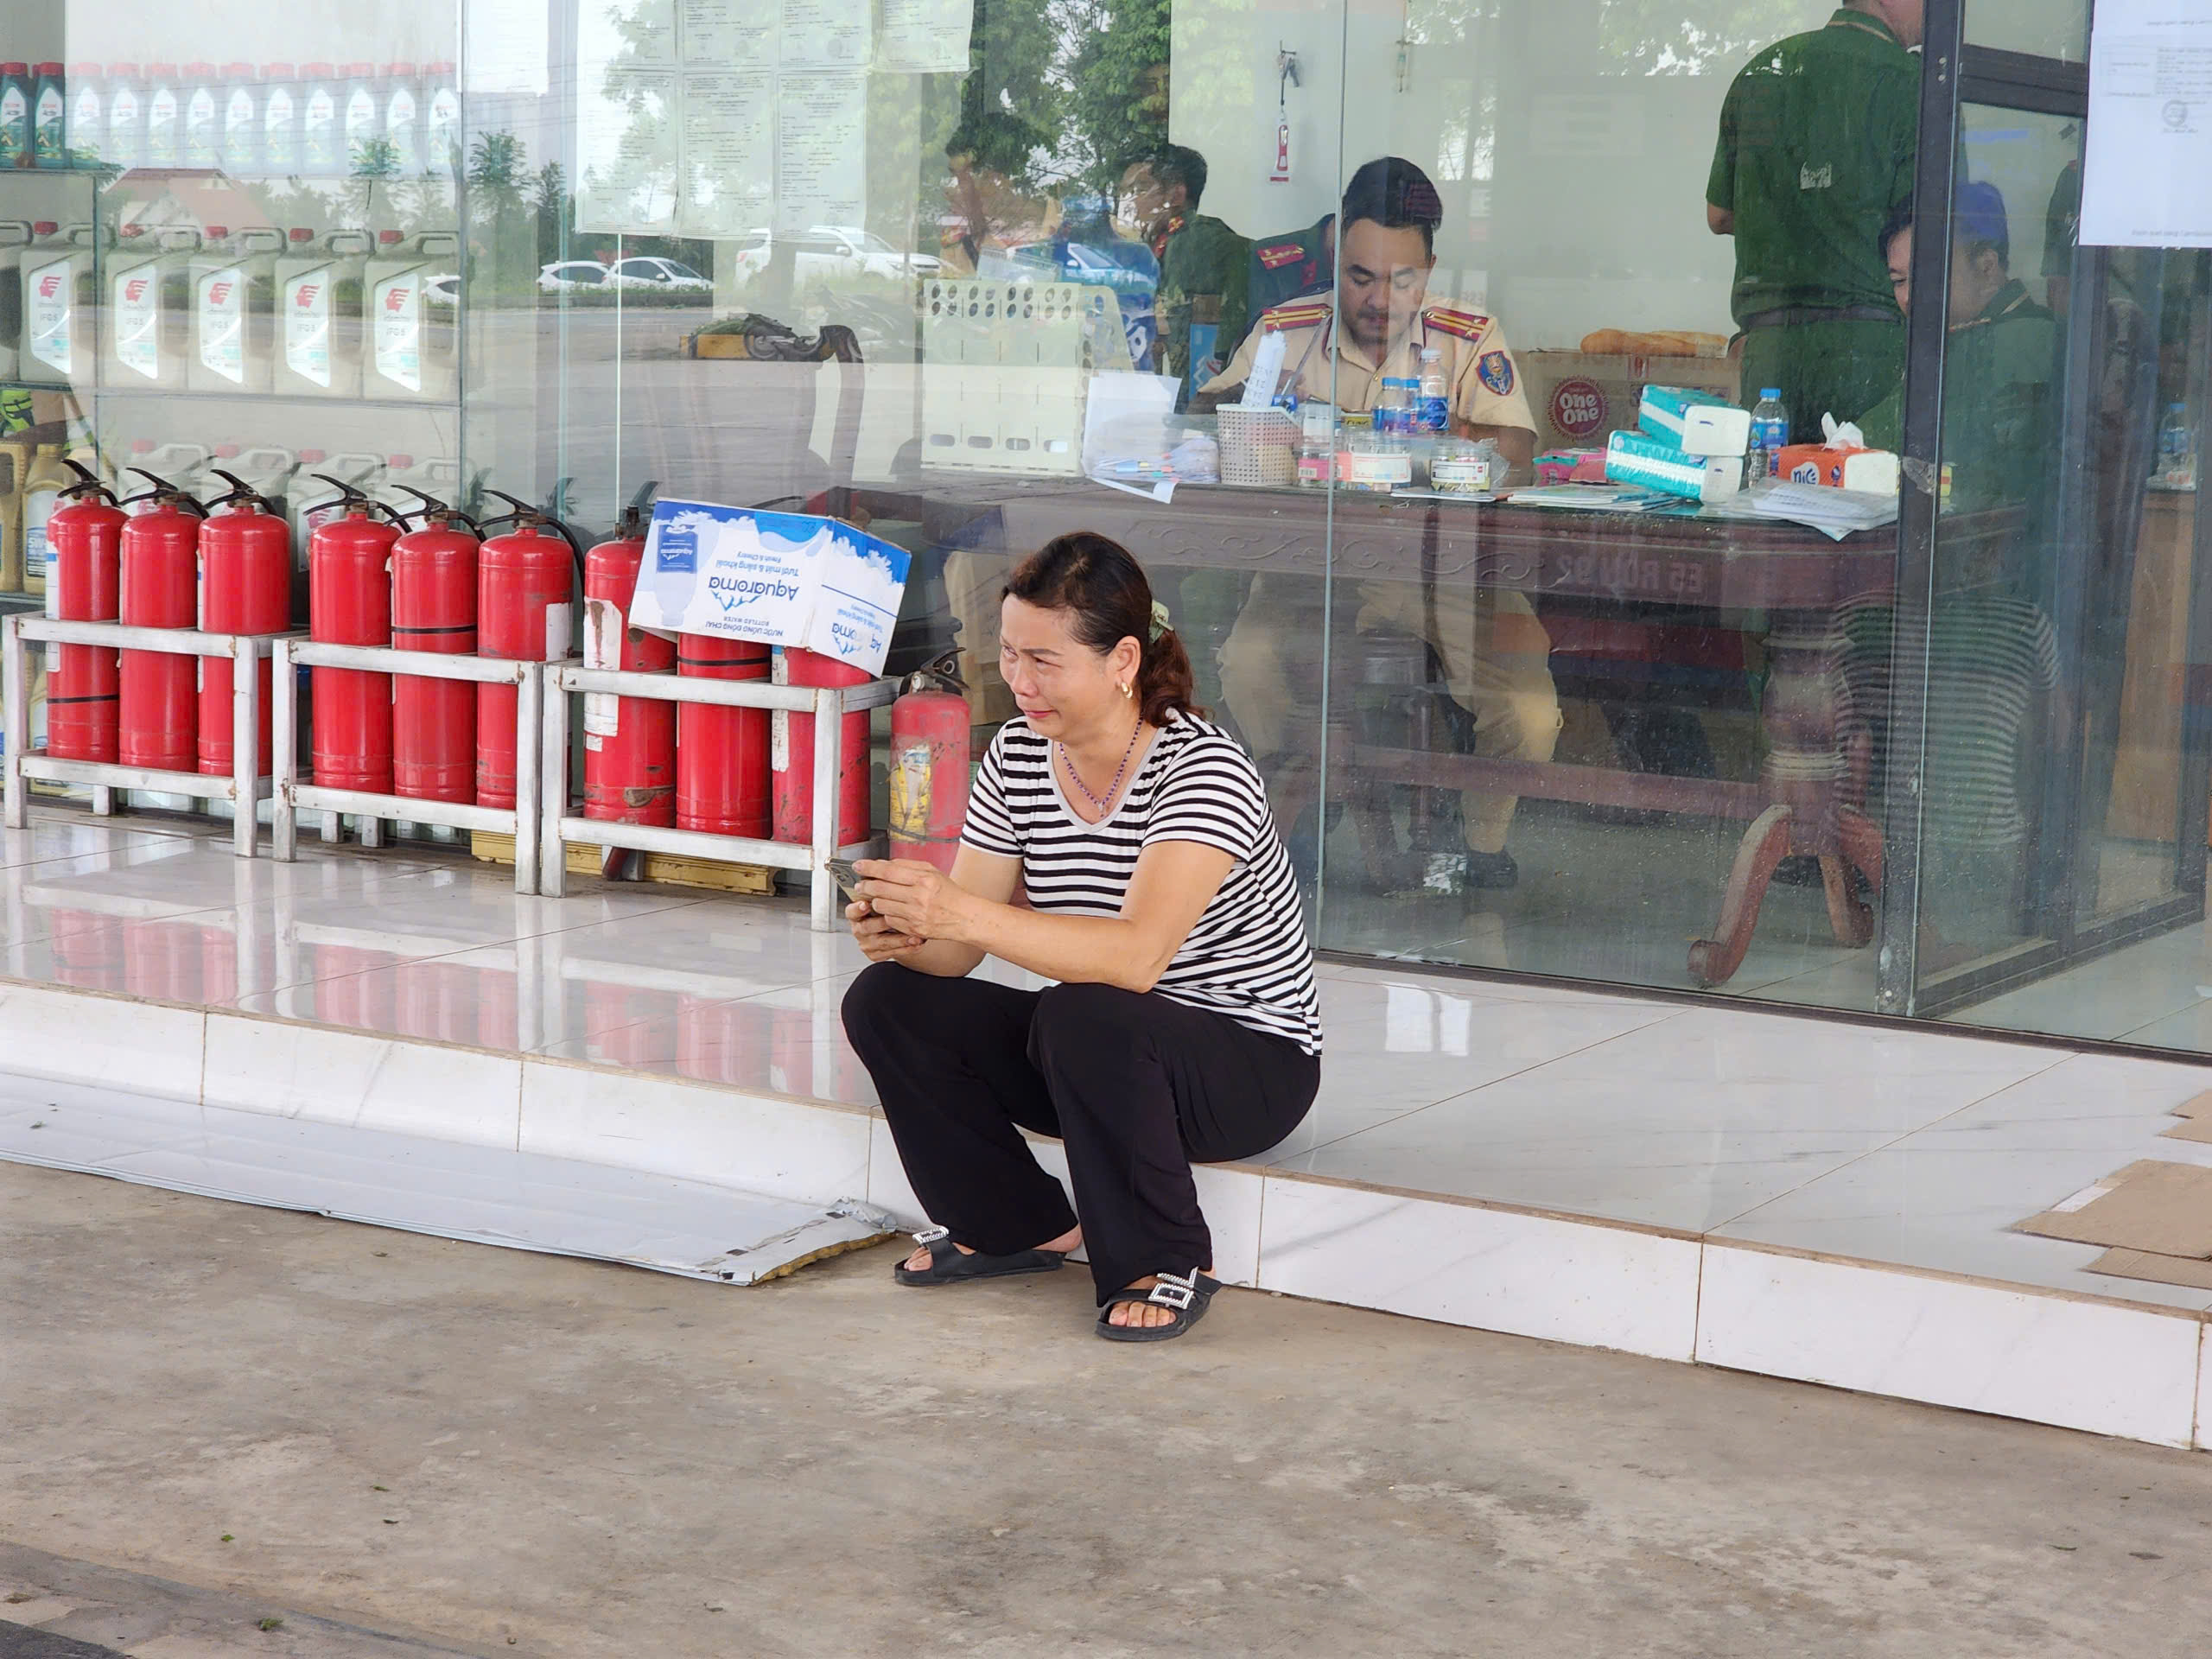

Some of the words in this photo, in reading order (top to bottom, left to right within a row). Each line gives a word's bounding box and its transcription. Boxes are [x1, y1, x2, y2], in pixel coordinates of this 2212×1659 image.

[1559, 392, 1597, 410] One
[1562, 407, 1599, 424] One
[709, 576, 799, 601] Aquaroma
[742, 626, 762, 634] UỐNG
